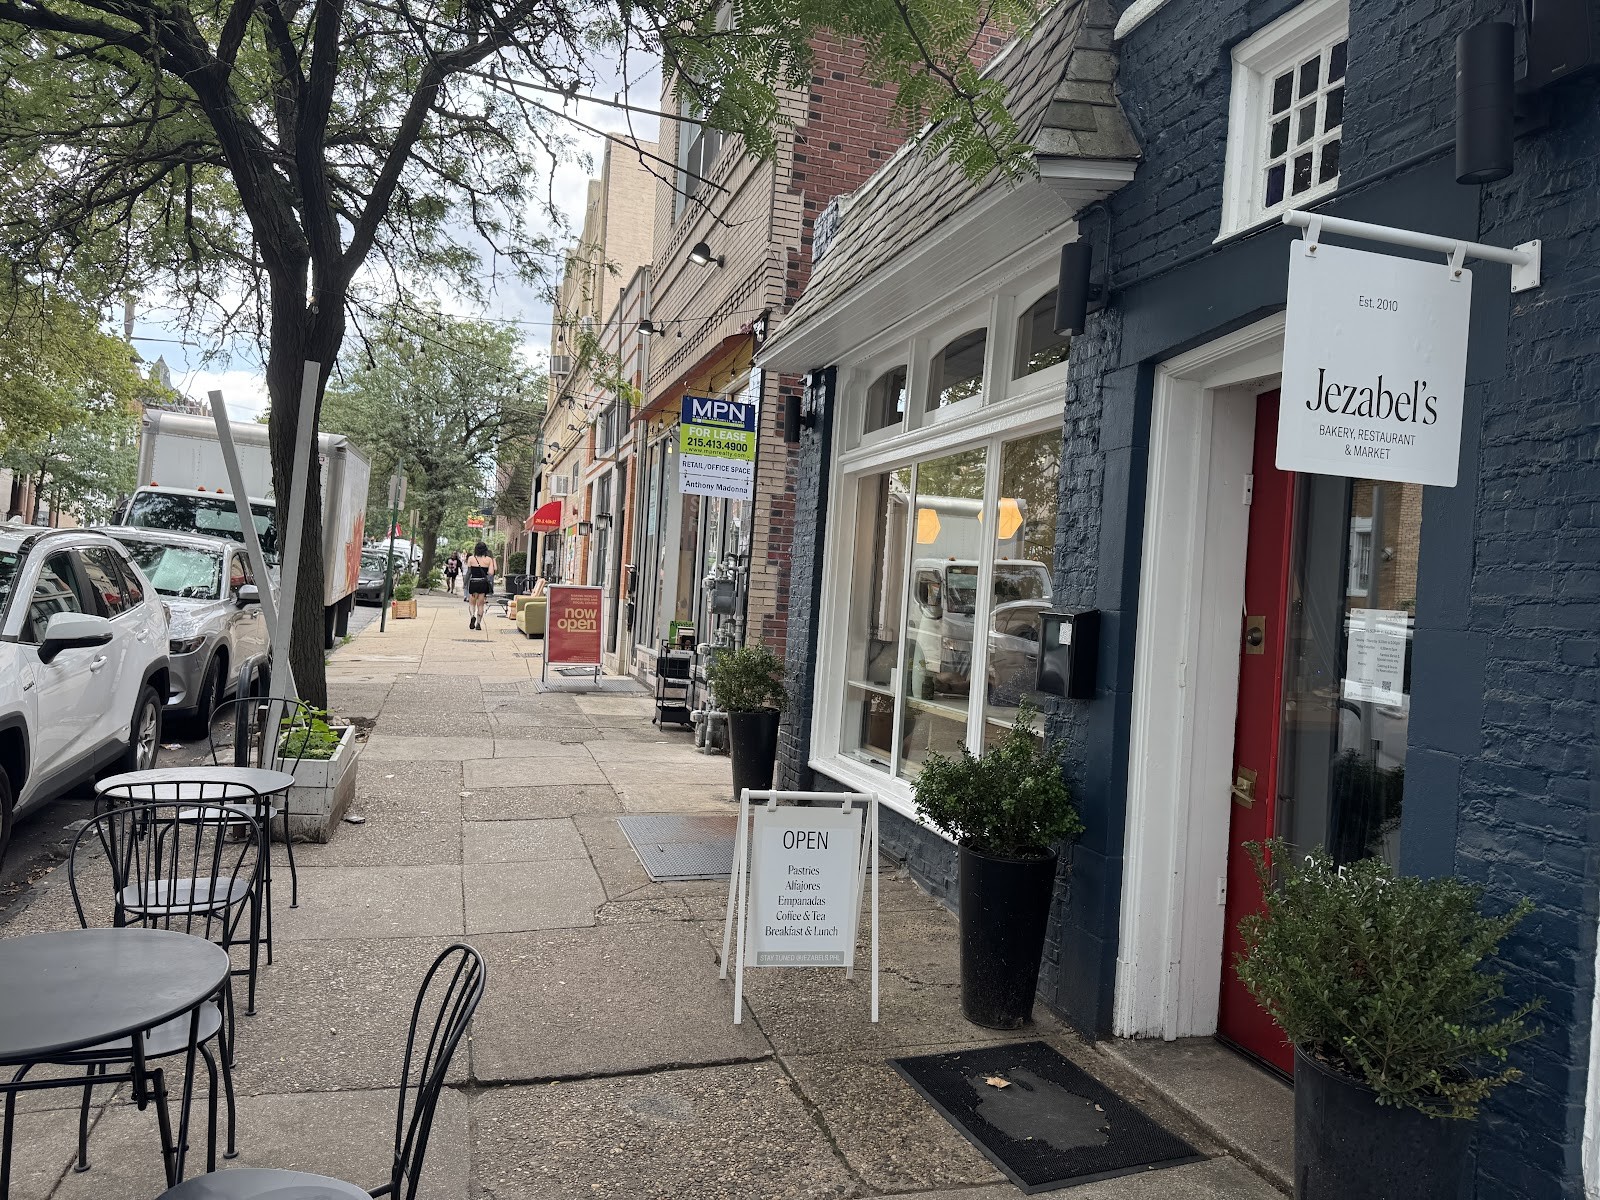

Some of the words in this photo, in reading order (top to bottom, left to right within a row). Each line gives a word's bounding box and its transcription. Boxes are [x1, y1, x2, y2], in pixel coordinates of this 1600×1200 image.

[1358, 295, 1375, 309] Est.
[1377, 298, 1398, 312] 2010
[1305, 368, 1438, 425] Jezabel's
[692, 398, 746, 421] MPN
[689, 426, 711, 438] FOR
[713, 429, 747, 443] LEASE
[1319, 424, 1356, 441] BAKERY,
[1358, 429, 1416, 446] RESTAURANT
[687, 437, 748, 452] 215.413.4900
[1344, 444, 1352, 456] &
[1353, 446, 1391, 460] MARKET
[730, 466, 751, 475] SPACE
[685, 480, 715, 491] Anthony
[715, 483, 748, 494] Madonna
[564, 607, 598, 619] now
[557, 618, 597, 633] open
[783, 830, 829, 850] OPEN
[788, 864, 820, 876] Pastries
[785, 880, 821, 893] Alfajores
[778, 895, 826, 908] Empanadas
[776, 910, 802, 921] Coffee
[802, 911, 811, 921] &
[811, 910, 826, 921] Tea
[765, 925, 803, 937] Breakfast
[804, 926, 812, 937] &
[813, 926, 838, 937] Lunch
